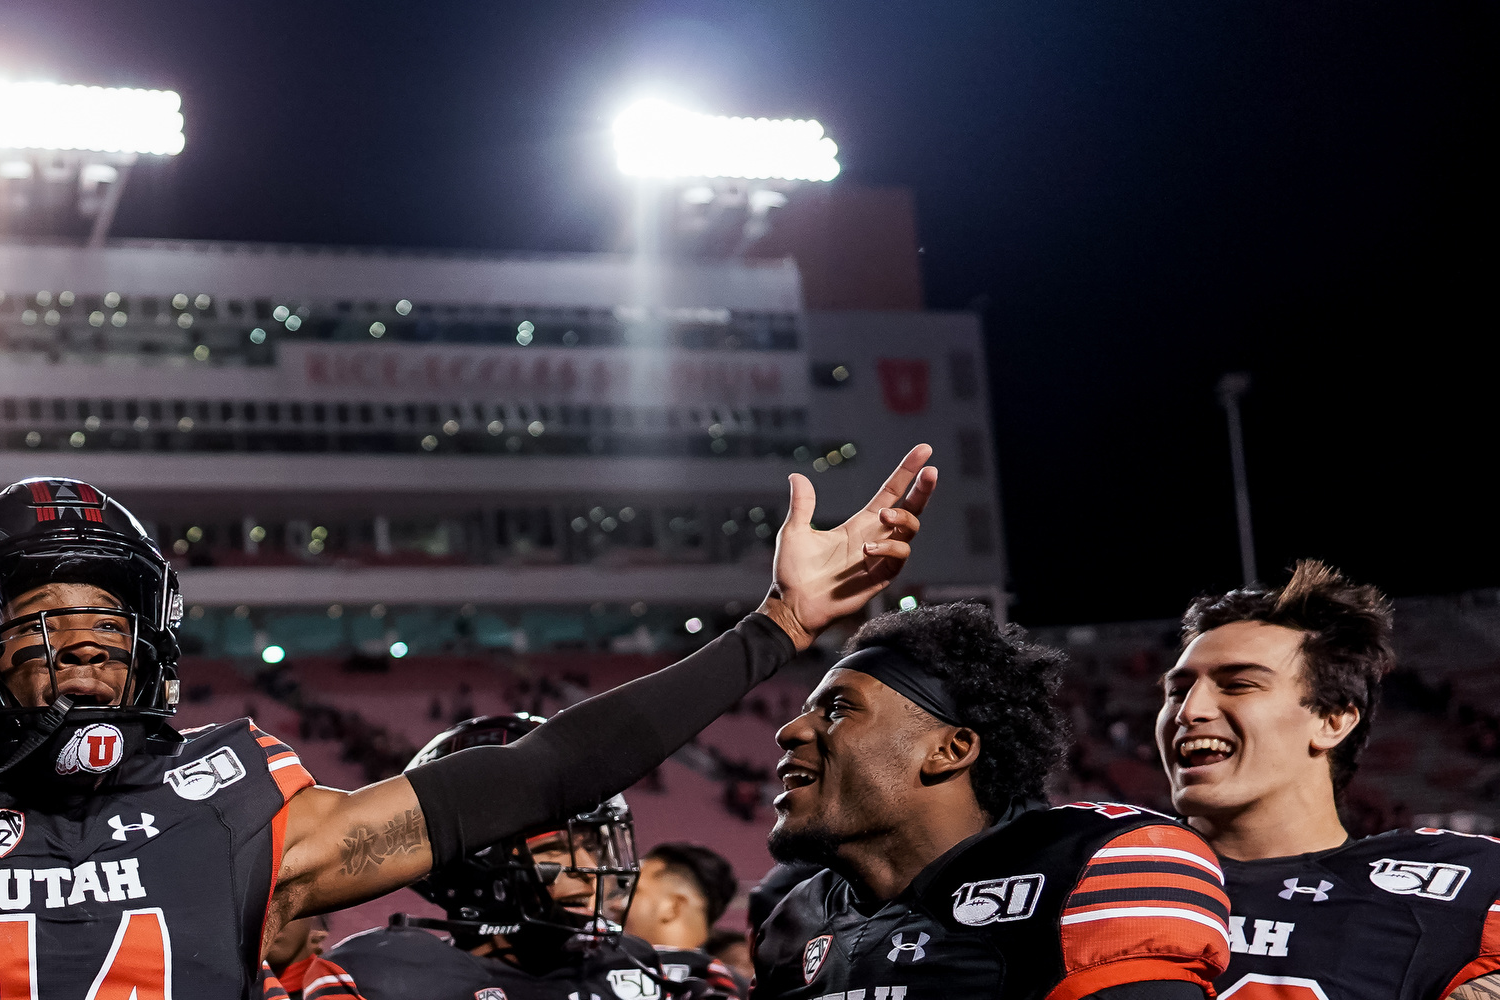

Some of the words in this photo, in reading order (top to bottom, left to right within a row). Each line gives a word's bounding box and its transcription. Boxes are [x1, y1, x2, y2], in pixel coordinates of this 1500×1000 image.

[87, 735, 117, 768] U
[163, 746, 246, 800] 150
[951, 873, 1045, 926] 150
[1369, 858, 1471, 901] 150
